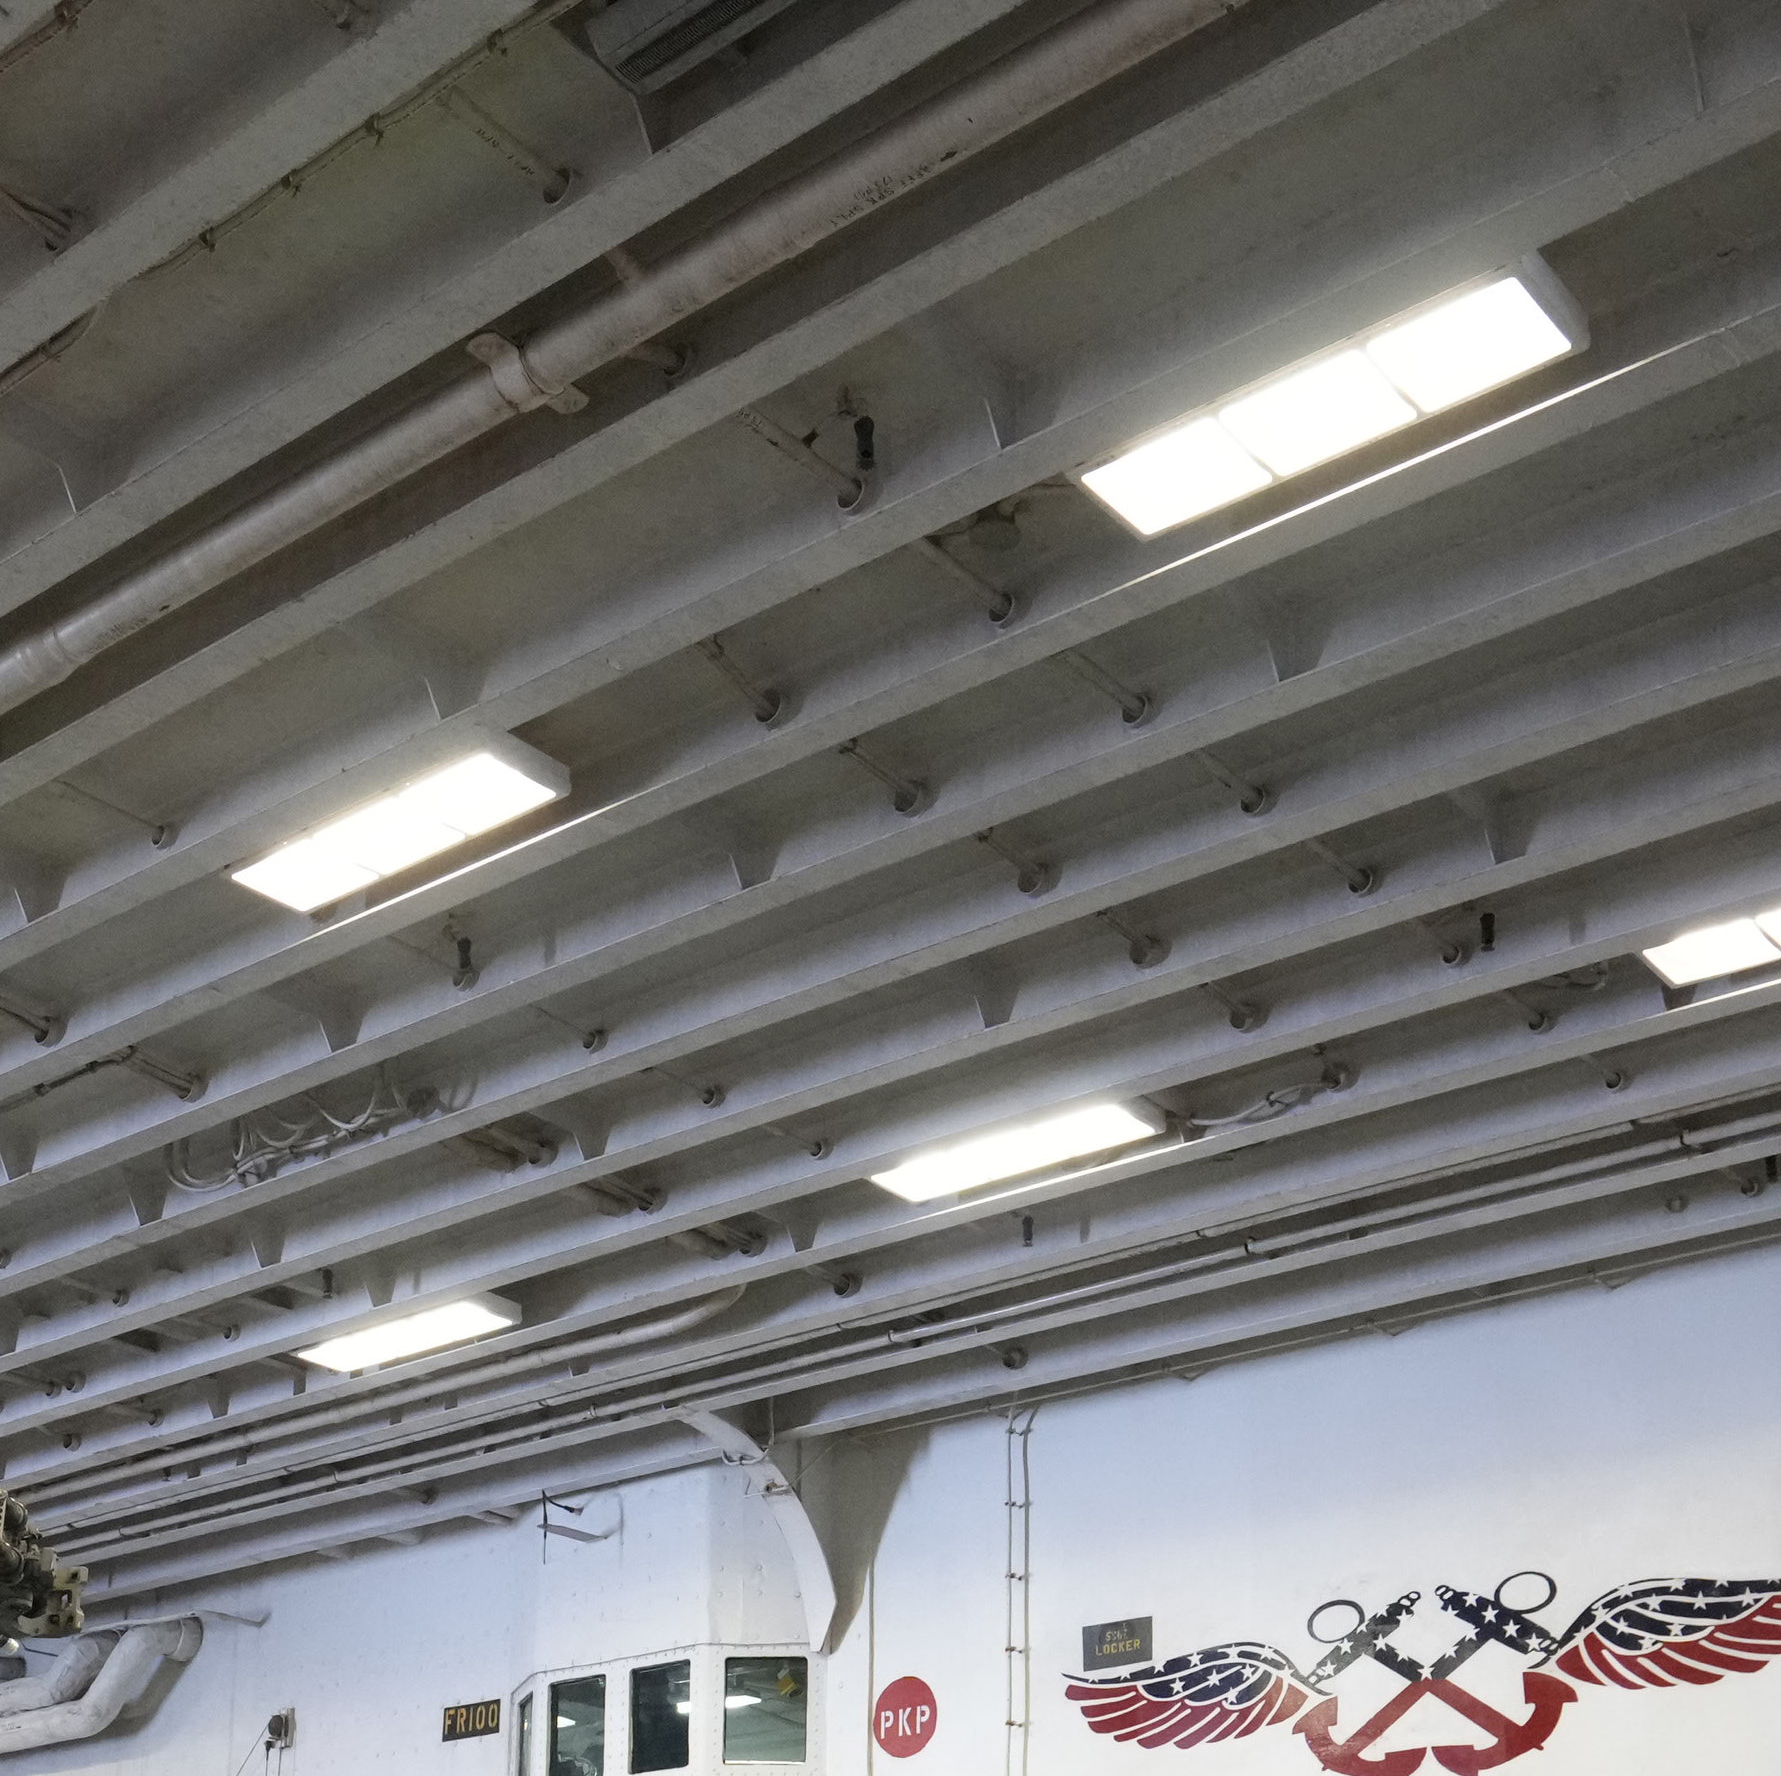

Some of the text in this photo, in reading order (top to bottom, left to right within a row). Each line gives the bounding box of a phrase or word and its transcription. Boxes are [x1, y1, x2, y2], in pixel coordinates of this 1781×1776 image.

[1095, 1638, 1141, 1656] LOCKER
[444, 1704, 499, 1736] FR100
[880, 1704, 931, 1740] PKP
